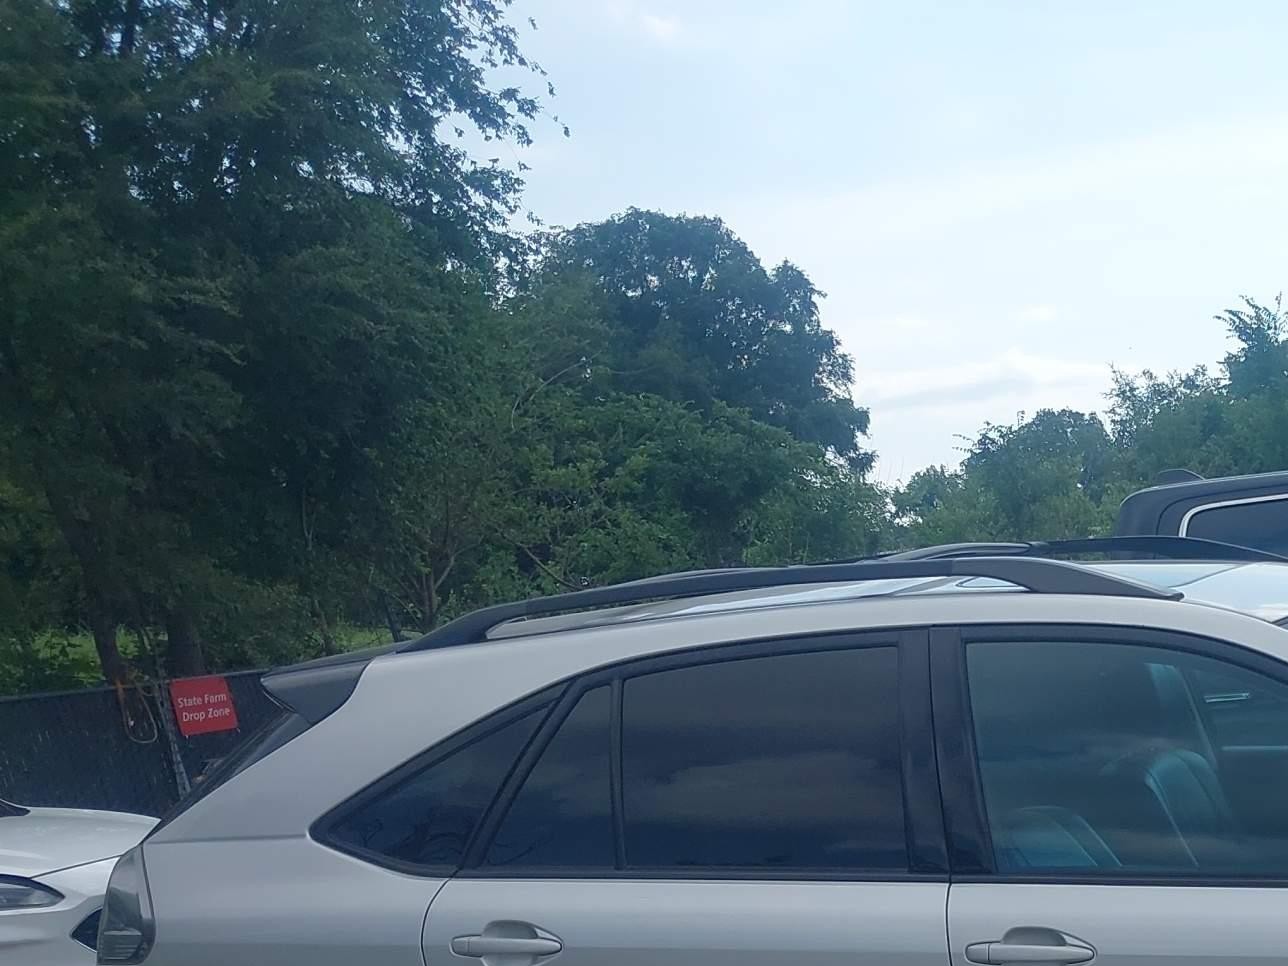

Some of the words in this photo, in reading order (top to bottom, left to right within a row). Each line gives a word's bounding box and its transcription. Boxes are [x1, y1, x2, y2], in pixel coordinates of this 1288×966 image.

[177, 696, 203, 708] State
[204, 693, 227, 704] Farm
[182, 711, 206, 722] Drop
[207, 707, 231, 718] Zone
